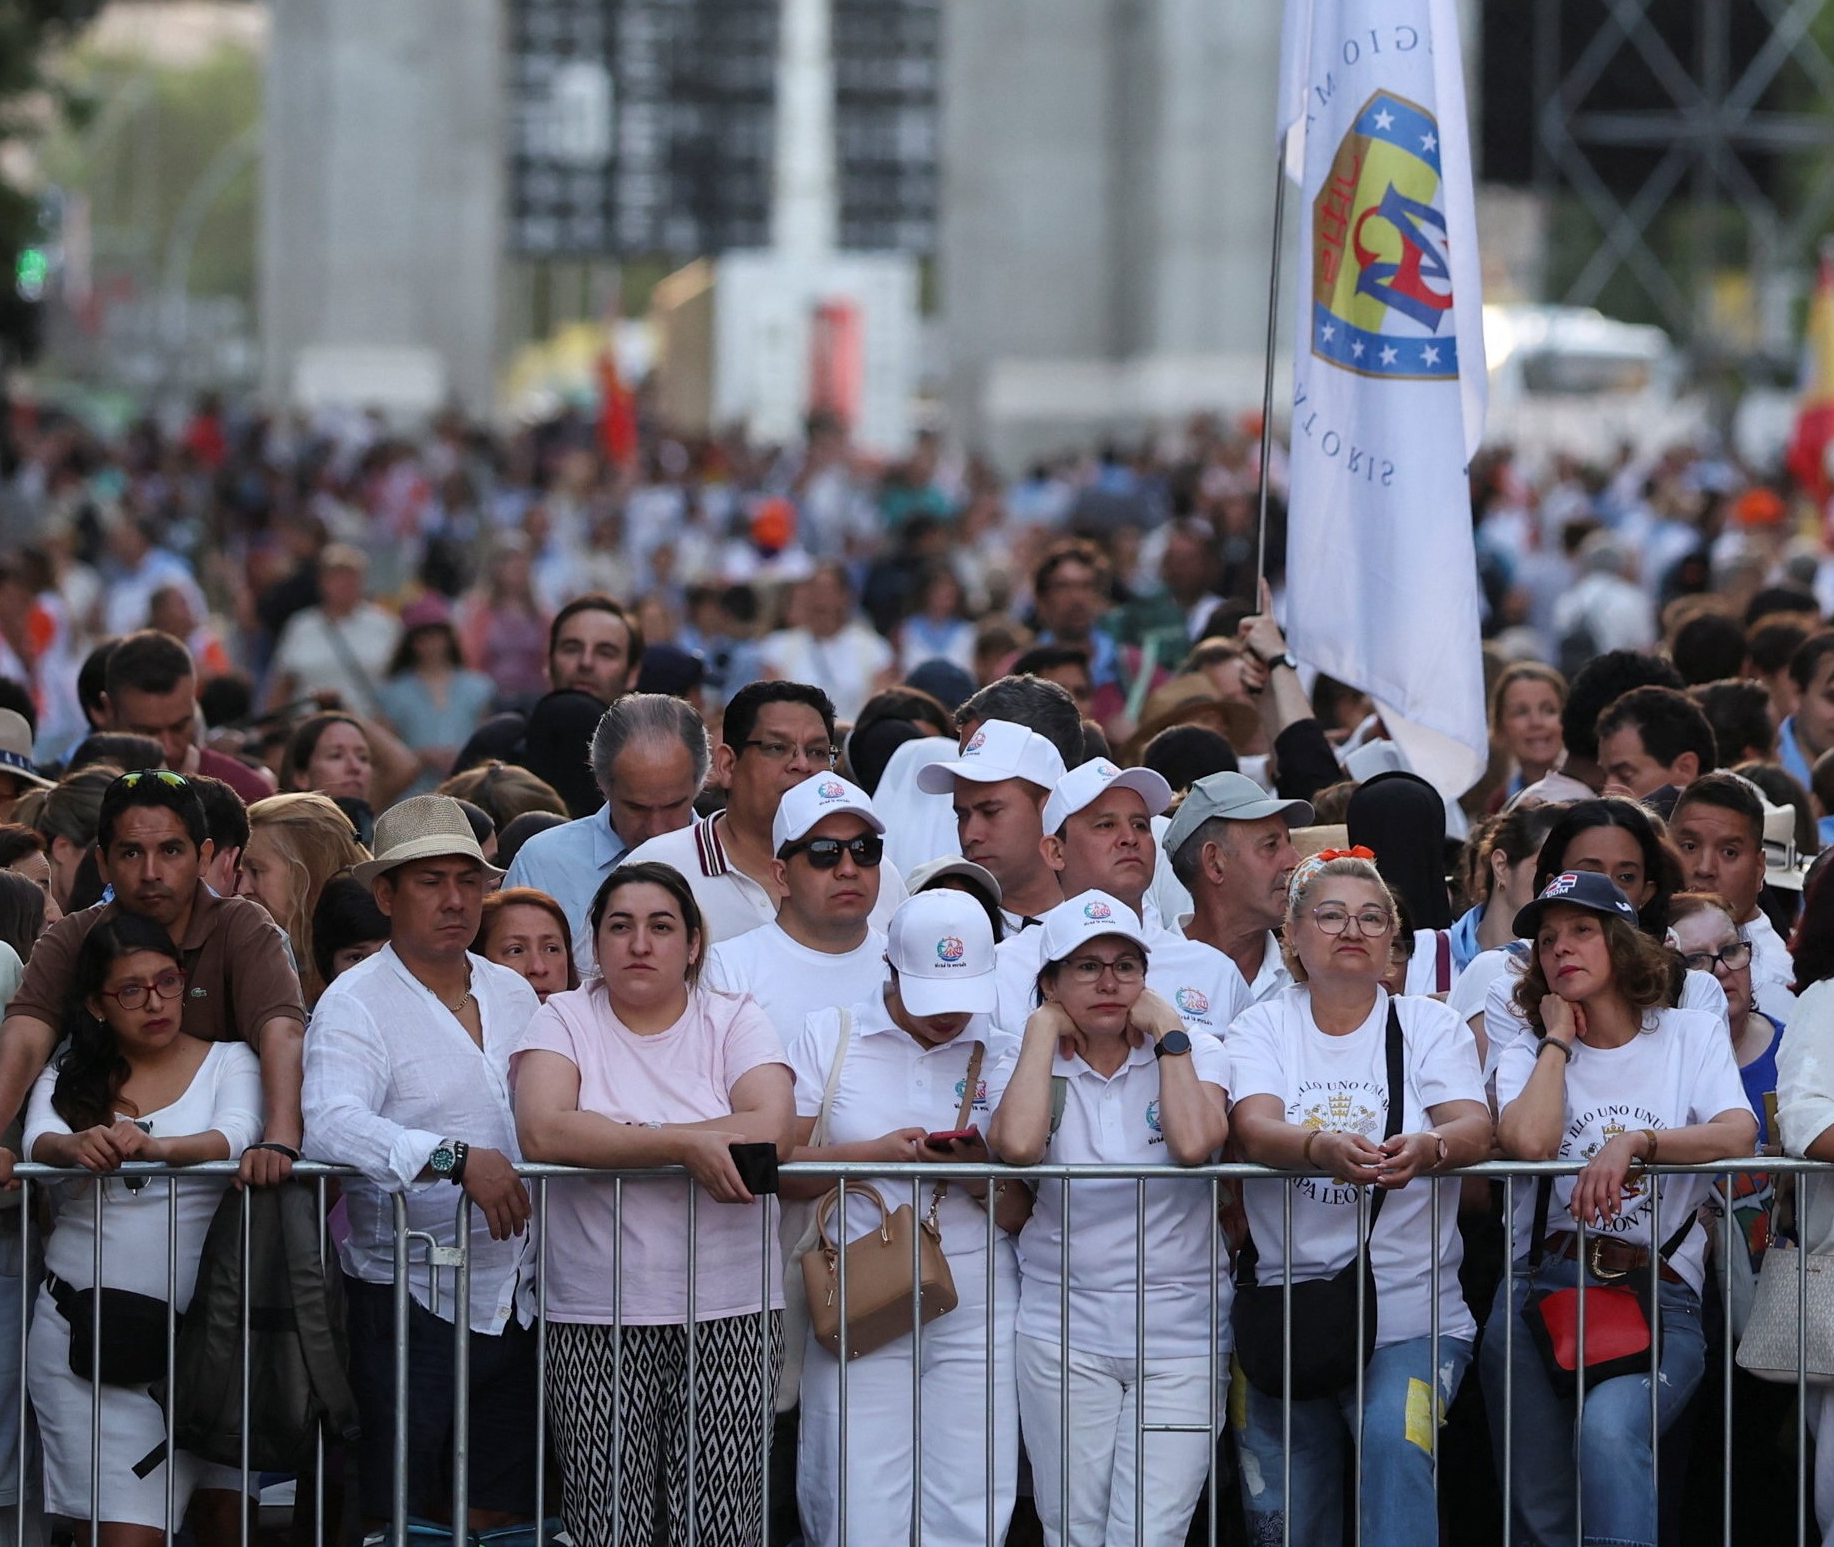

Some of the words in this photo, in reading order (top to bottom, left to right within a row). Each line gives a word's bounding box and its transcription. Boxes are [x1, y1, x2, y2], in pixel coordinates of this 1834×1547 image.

[1545, 886, 1569, 899] DOM
[1327, 1080, 1359, 1091] UNO
[1559, 1140, 1572, 1158] IN
[1569, 1112, 1594, 1139] ILLO
[1597, 1105, 1630, 1118] UNO
[1634, 1107, 1668, 1131] UNU
[1294, 1177, 1316, 1201] PA
